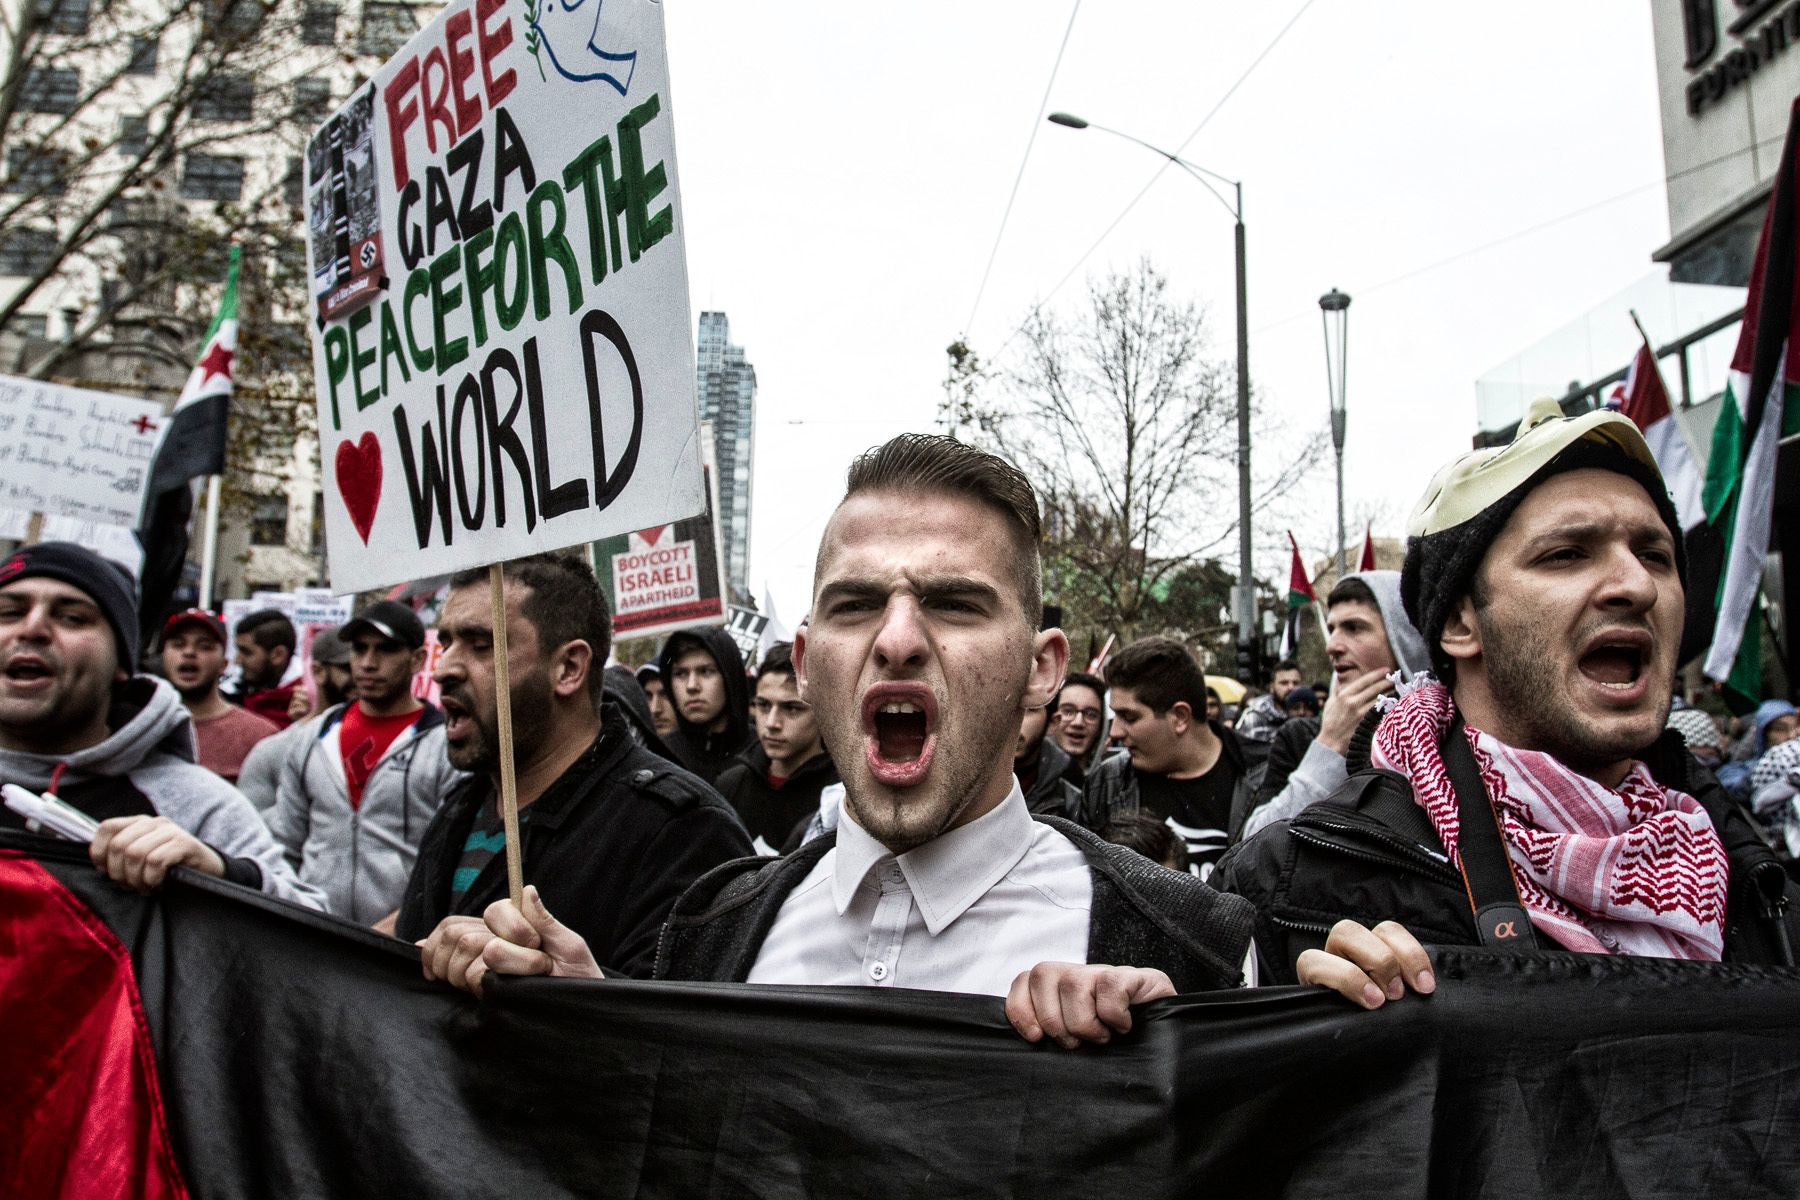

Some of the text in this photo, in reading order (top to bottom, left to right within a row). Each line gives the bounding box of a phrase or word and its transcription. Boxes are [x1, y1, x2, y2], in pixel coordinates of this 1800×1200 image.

[384, 0, 517, 192] FREE
[324, 93, 673, 430] PEACE FOR THE
[398, 107, 536, 270] GAZA
[392, 309, 643, 549] WORLD
[617, 546, 690, 572] BOYCOTT
[620, 564, 692, 593] ISRAELI
[620, 586, 695, 610] APARTHEID
